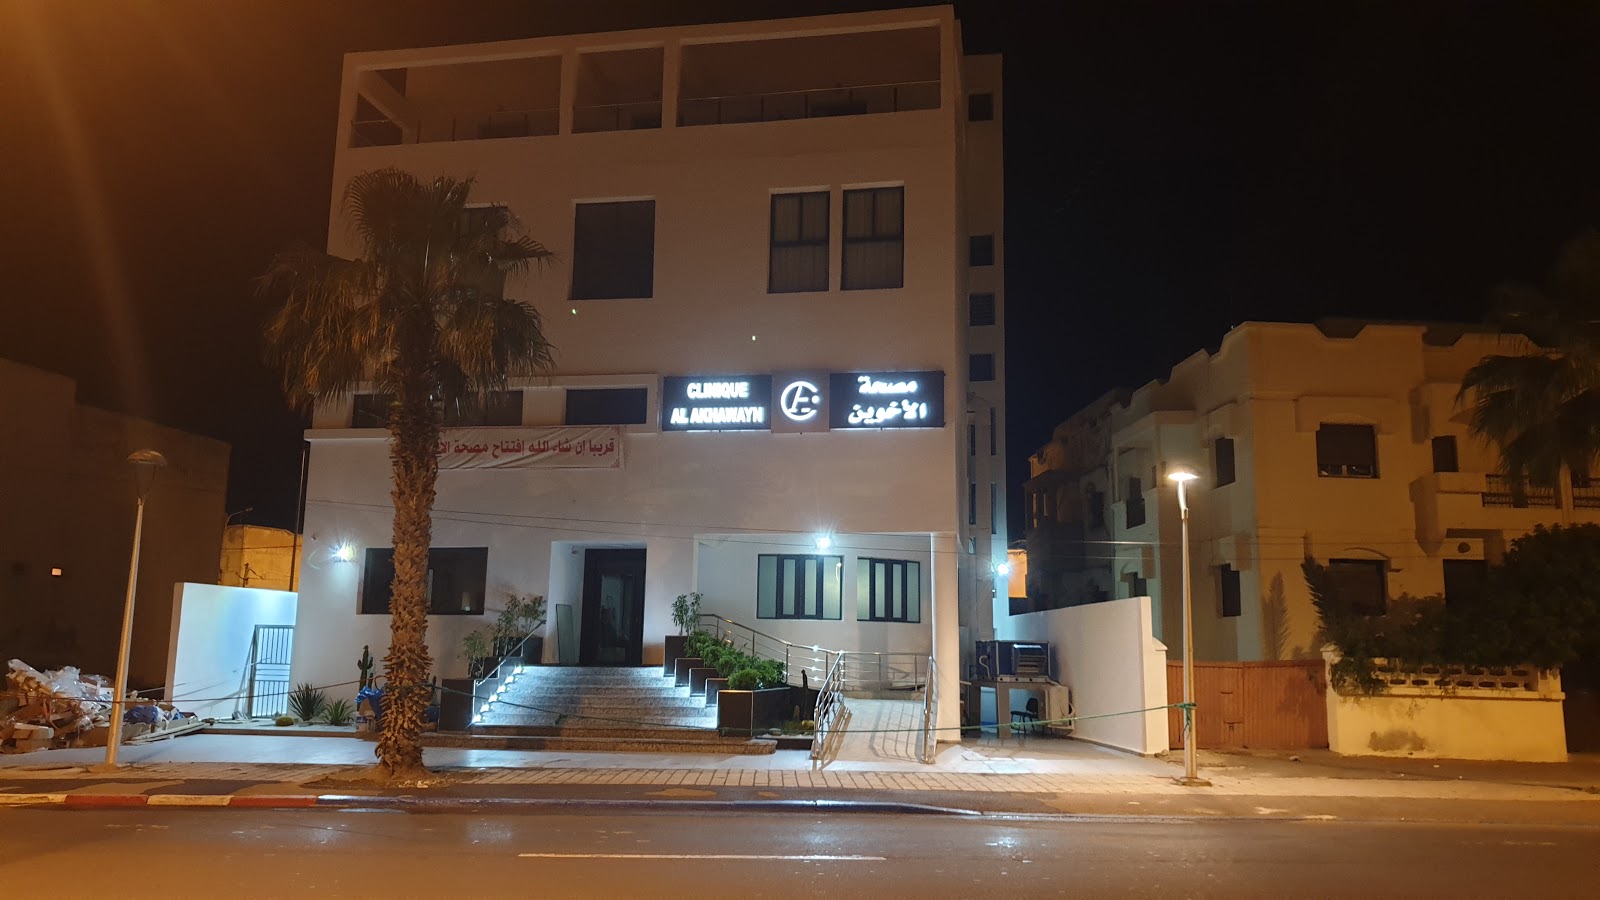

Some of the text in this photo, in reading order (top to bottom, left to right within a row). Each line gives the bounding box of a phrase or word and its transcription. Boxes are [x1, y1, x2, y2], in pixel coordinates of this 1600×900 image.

[687, 382, 749, 399] CLINIQUE
[857, 375, 918, 394] مصحة
[670, 406, 764, 424] AL AKHAWAYN
[454, 440, 489, 454] مصحة
[528, 439, 549, 453] الله
[552, 437, 572, 453] شاء
[589, 437, 615, 456] قريبا
